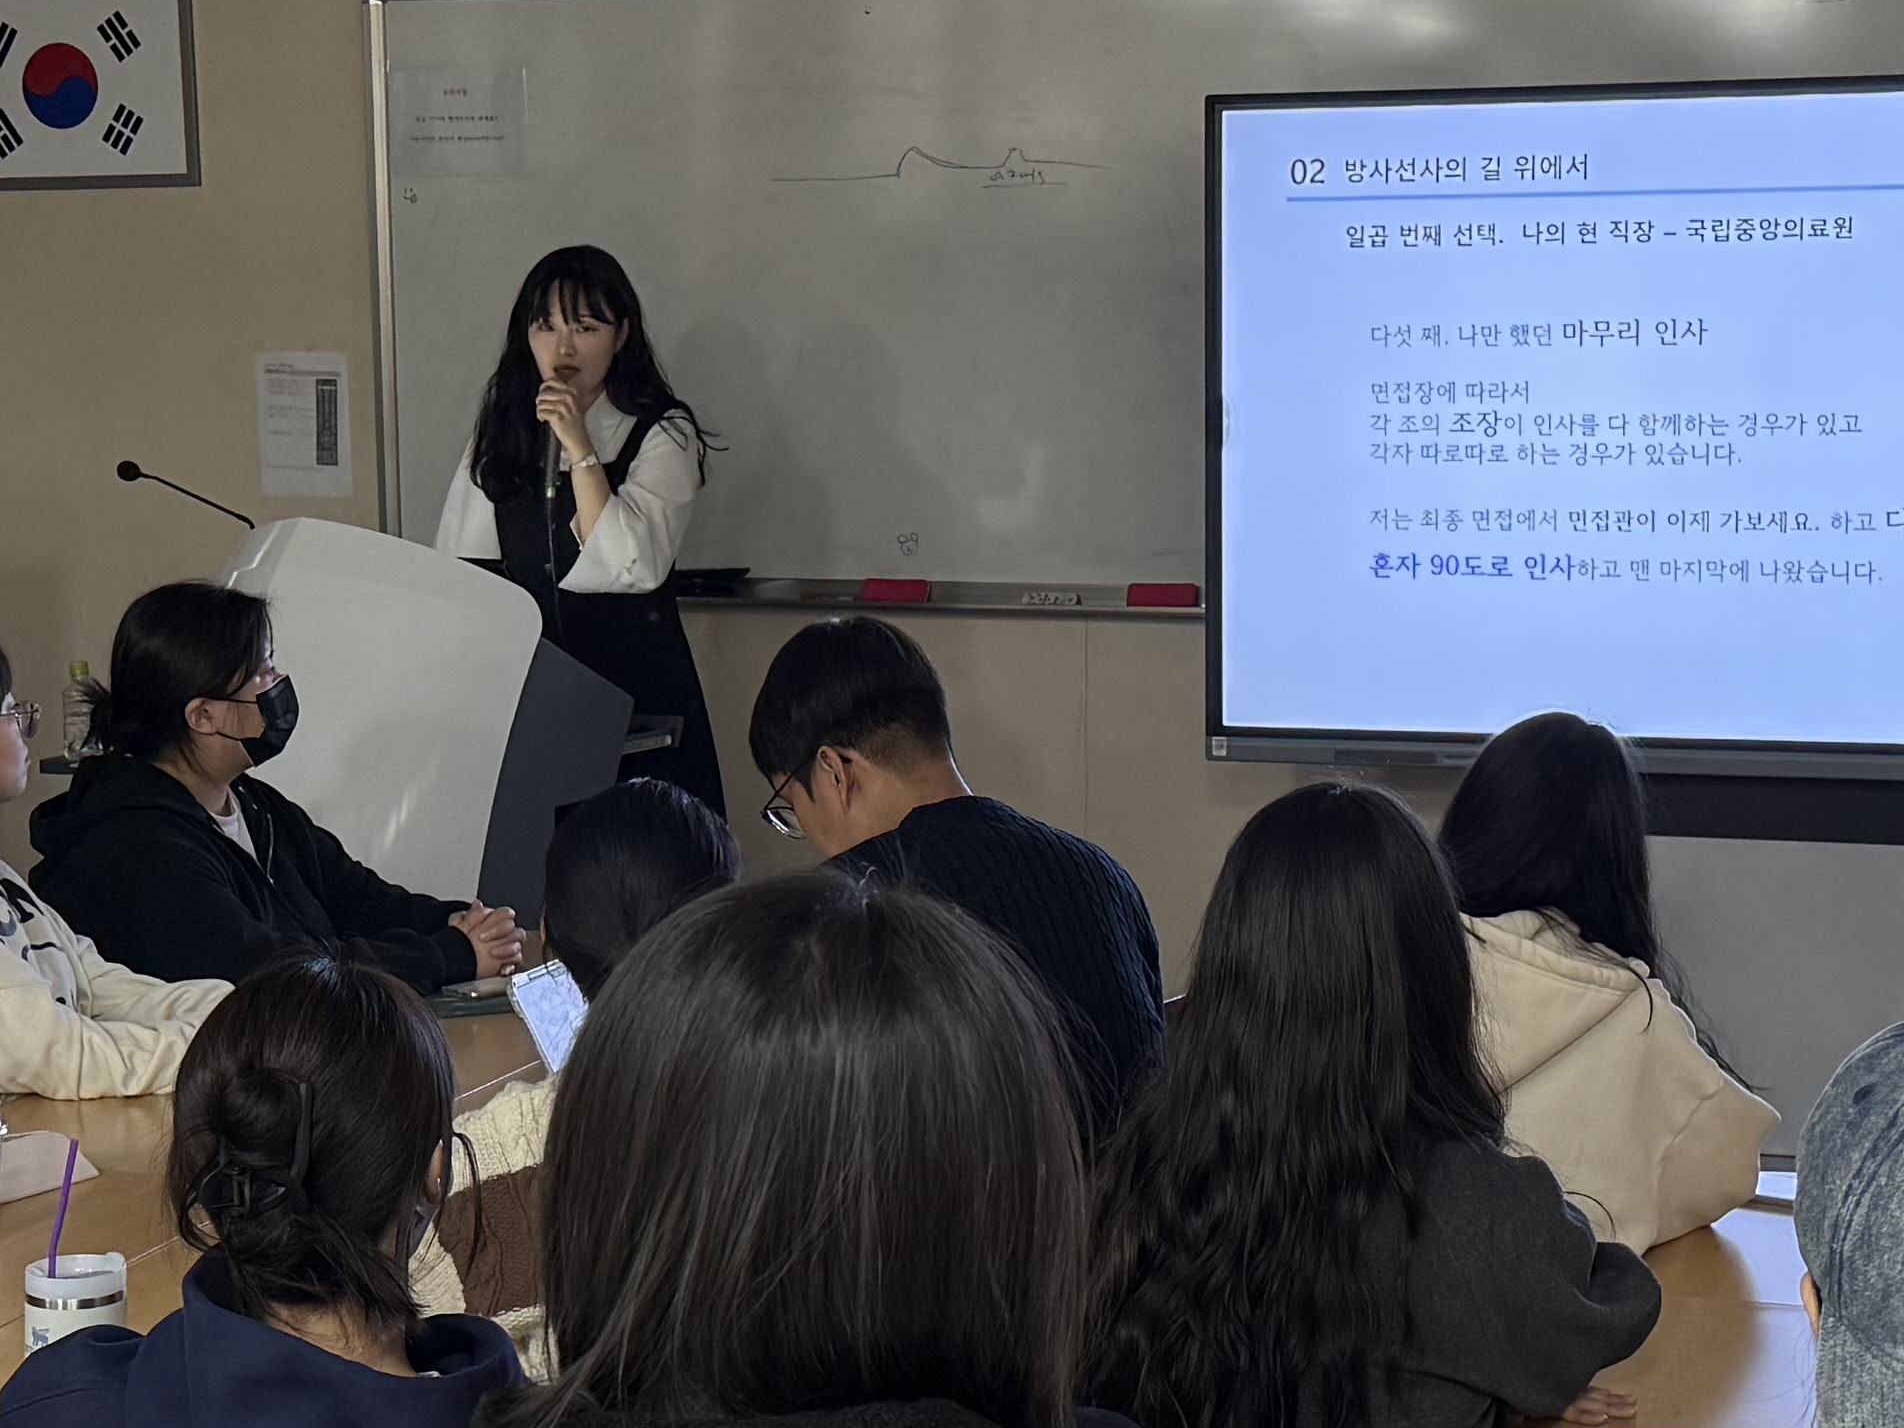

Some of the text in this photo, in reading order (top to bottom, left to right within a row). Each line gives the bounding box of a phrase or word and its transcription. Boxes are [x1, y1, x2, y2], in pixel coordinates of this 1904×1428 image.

[1291, 154, 1587, 185] 02 방사선사의 길 위에서
[1346, 225, 1389, 248] 일곱
[1400, 224, 1441, 247] 번째
[1523, 222, 1565, 245] 나의
[1577, 222, 1597, 244] 현
[1609, 220, 1654, 243] 직장
[1686, 216, 1852, 242] 국립중앙의료원
[1371, 324, 1411, 348] 다섯
[1459, 324, 1502, 347] 나만
[1510, 324, 1552, 347] 했던
[1563, 319, 1639, 347] 마무리
[1655, 318, 1708, 345] 인사
[1372, 381, 1528, 405] 면접장에 따라서
[1371, 410, 1862, 437] 각 조의 조장이 인사를 다 함께하는 경우가 있고
[1371, 442, 1741, 466] 각자 따로따로 하는 경우가 있습니다.
[1370, 508, 1413, 531] 저는
[1420, 508, 1463, 532] 최종
[1668, 510, 1709, 533] 이제
[1831, 511, 1876, 534] 하고
[1370, 553, 1421, 579] 혼자
[1431, 555, 1513, 576] 90도로
[1525, 554, 1621, 581] 인사하고
[1630, 559, 1649, 581] 맨
[1660, 559, 1749, 583] 마지막에
